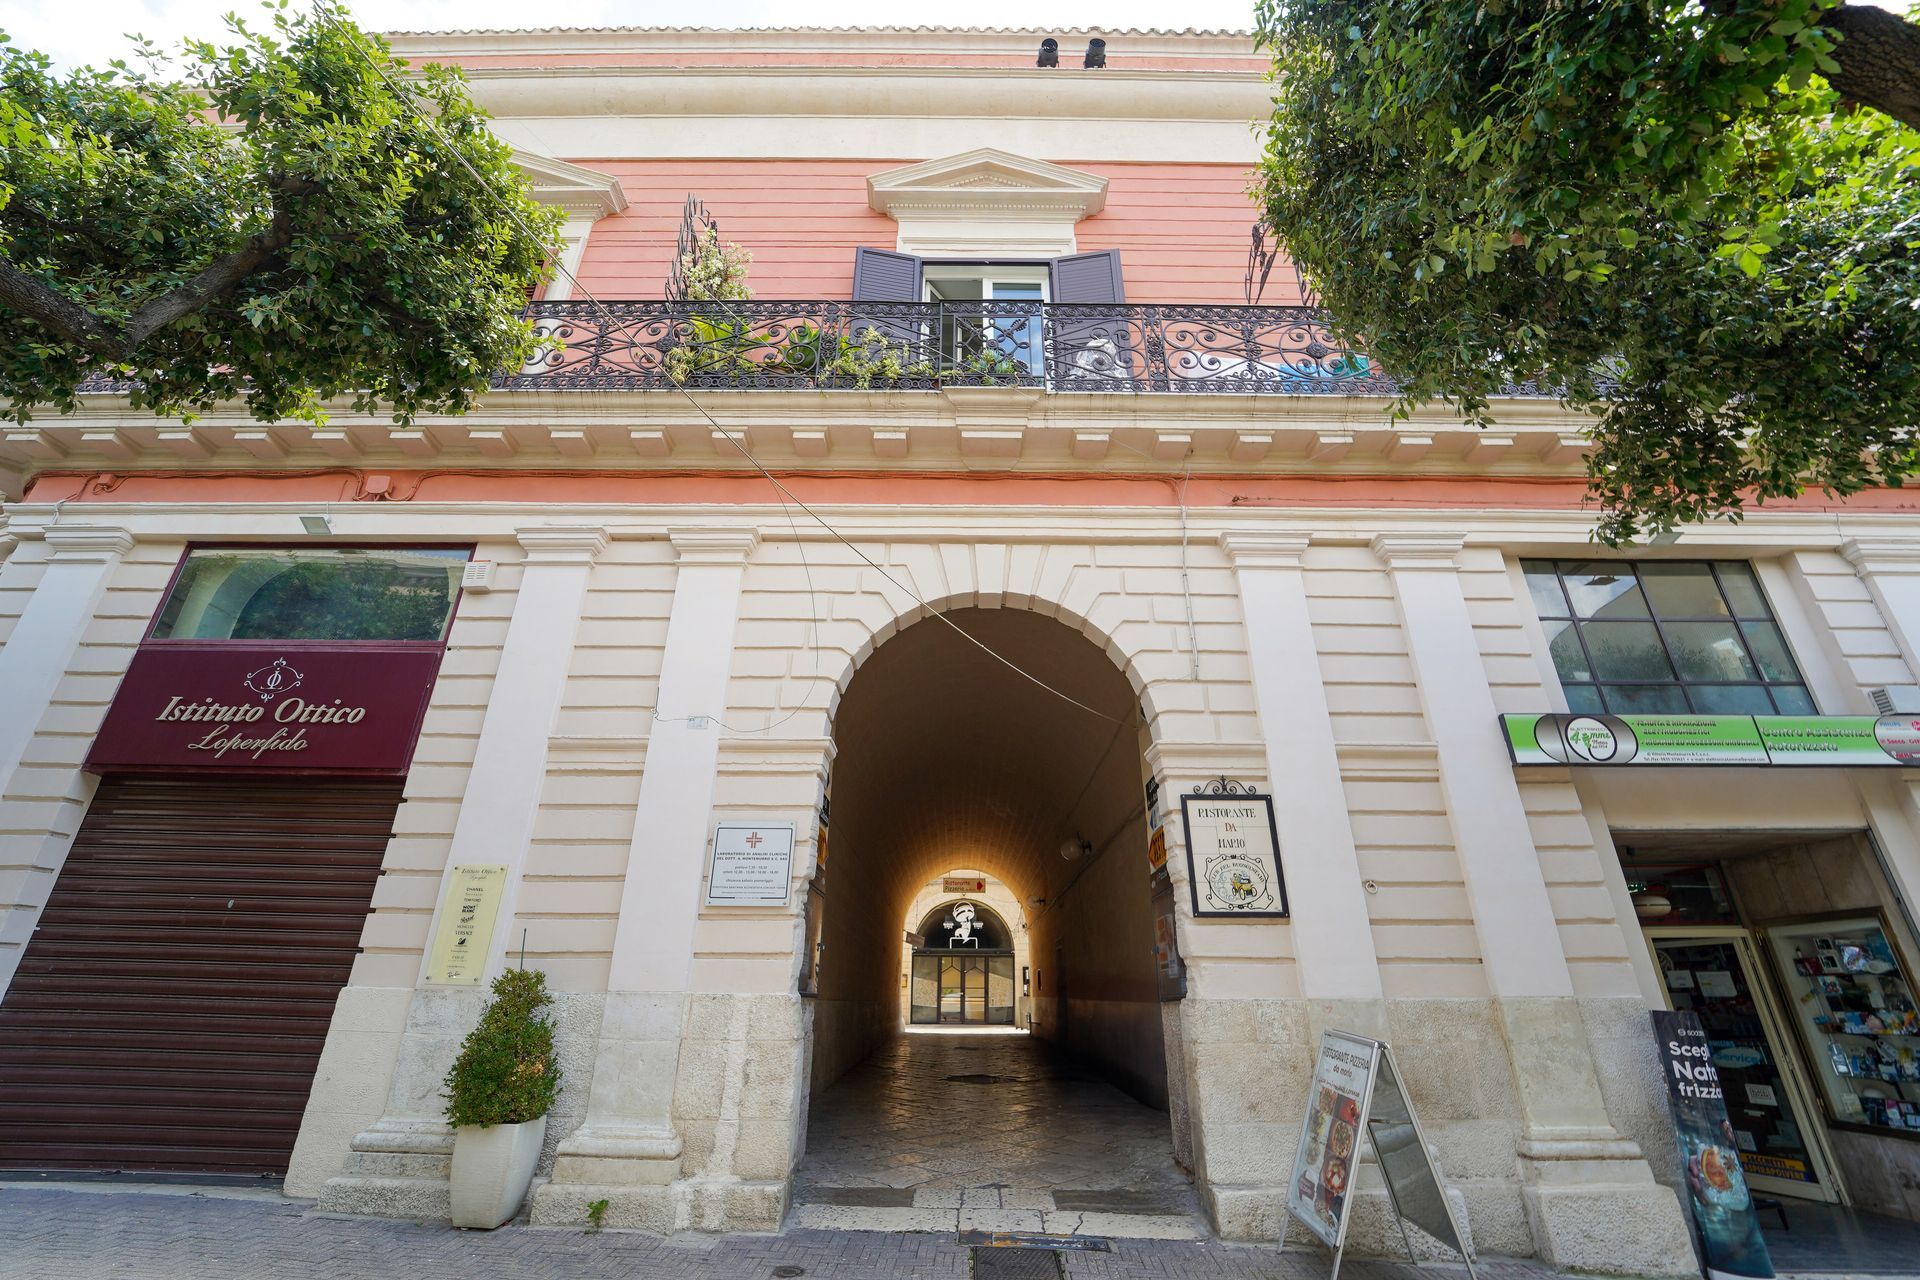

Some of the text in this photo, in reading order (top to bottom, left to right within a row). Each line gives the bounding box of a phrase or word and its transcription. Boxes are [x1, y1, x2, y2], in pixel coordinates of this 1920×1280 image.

[155, 696, 366, 724] Istituto Ottico
[1760, 727, 1872, 738] Centro Assistenza
[187, 723, 308, 759] Loperfido
[1767, 741, 1838, 752] Autorizzato
[1198, 808, 1256, 819] RISTORANTE
[1225, 822, 1237, 832] DA
[1218, 839, 1246, 849] MARIO
